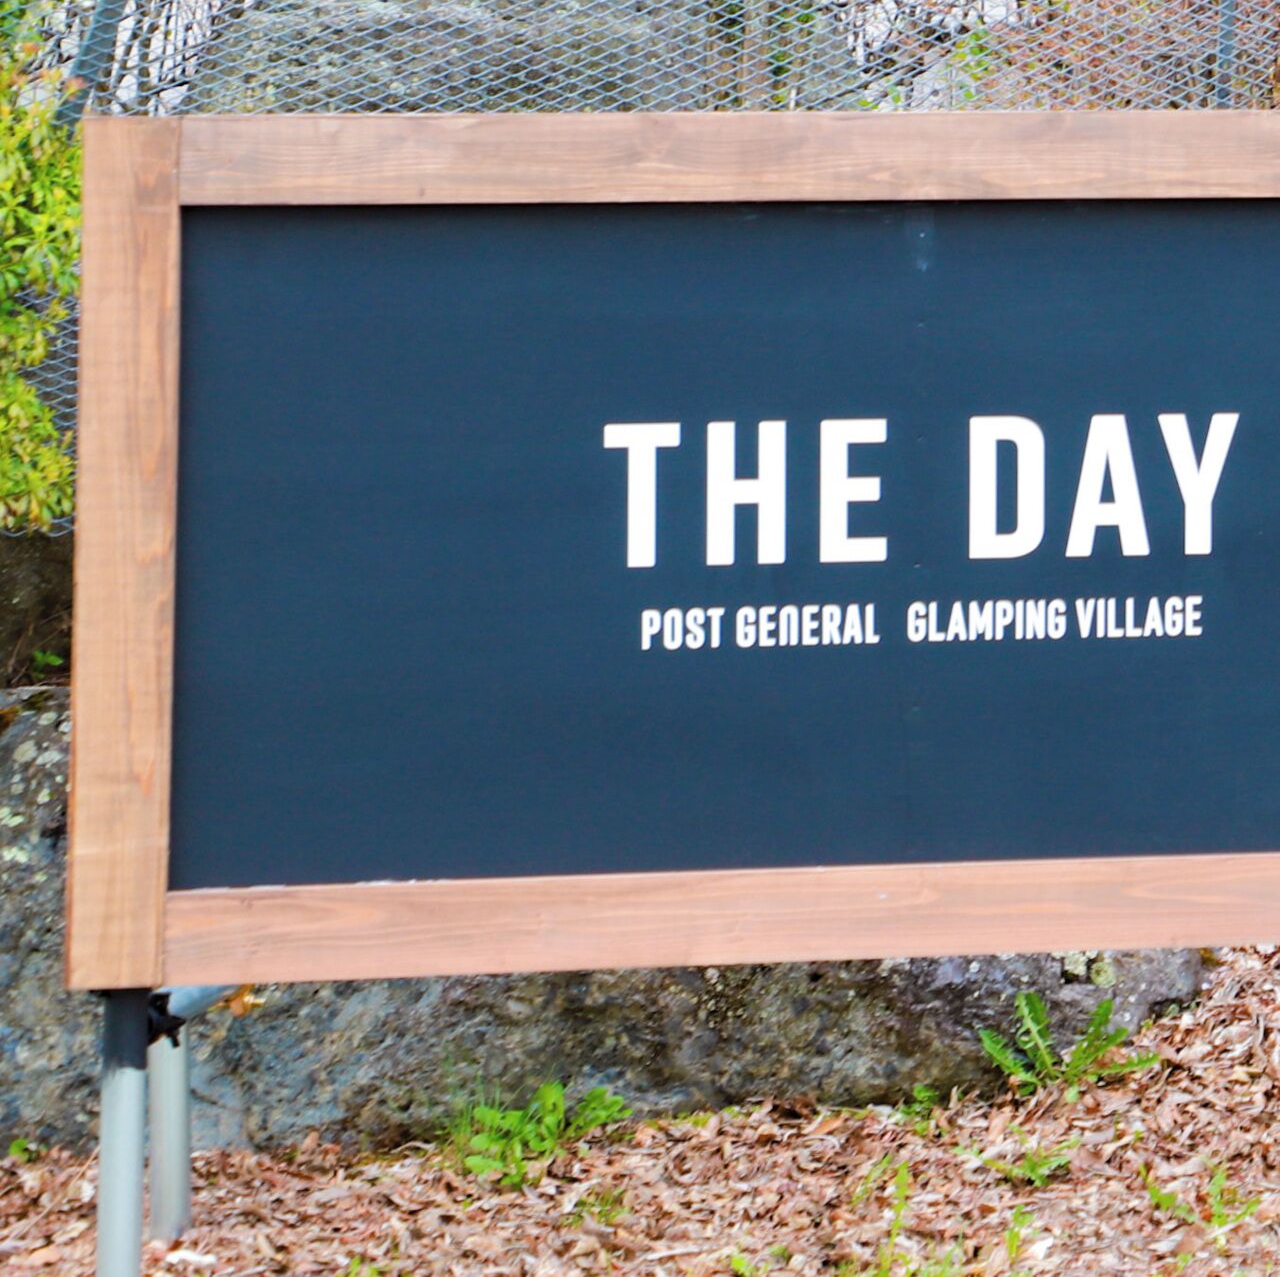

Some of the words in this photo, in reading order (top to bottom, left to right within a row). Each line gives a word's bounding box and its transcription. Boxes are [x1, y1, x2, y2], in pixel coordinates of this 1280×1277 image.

[603, 418, 888, 568] THE
[968, 412, 1240, 560] DAY
[641, 607, 725, 651] POST
[735, 603, 880, 648] GENERAL
[907, 598, 1067, 643] GLAMPING
[1075, 595, 1203, 639] VILLAGE
